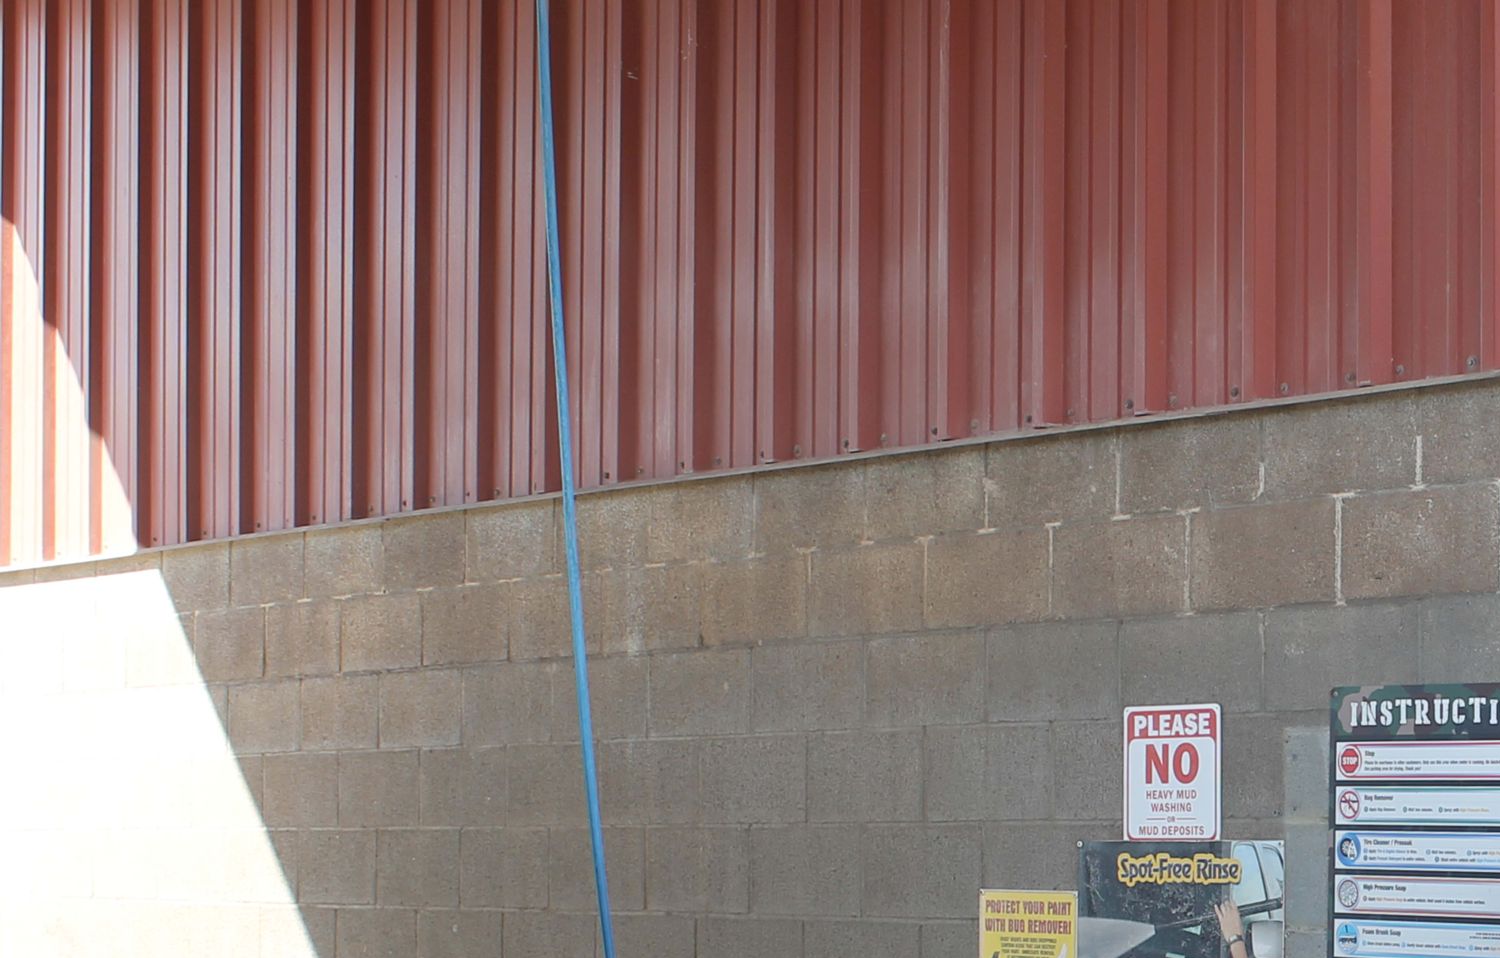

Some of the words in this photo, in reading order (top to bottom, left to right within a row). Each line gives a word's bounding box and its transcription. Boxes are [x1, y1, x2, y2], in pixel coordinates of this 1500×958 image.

[1134, 713, 1211, 737] PLEASE
[1145, 742, 1200, 785] NO
[1342, 756, 1358, 766] STOP
[1146, 790, 1174, 800] HEAVY
[1176, 789, 1197, 800] MUD
[1150, 803, 1192, 813] WASHING
[1139, 826, 1159, 836] MUD
[1161, 825, 1205, 836] DEPOSITS
[1119, 856, 1191, 881] Spot-Free
[1196, 858, 1240, 881] Rinse
[985, 900, 1021, 914] PROTECT
[1023, 901, 1045, 914] YOUR
[1047, 902, 1072, 916] PAINT
[985, 918, 1006, 932] WITH
[1008, 919, 1025, 933] BUG
[1028, 920, 1072, 935] REMOVER!
